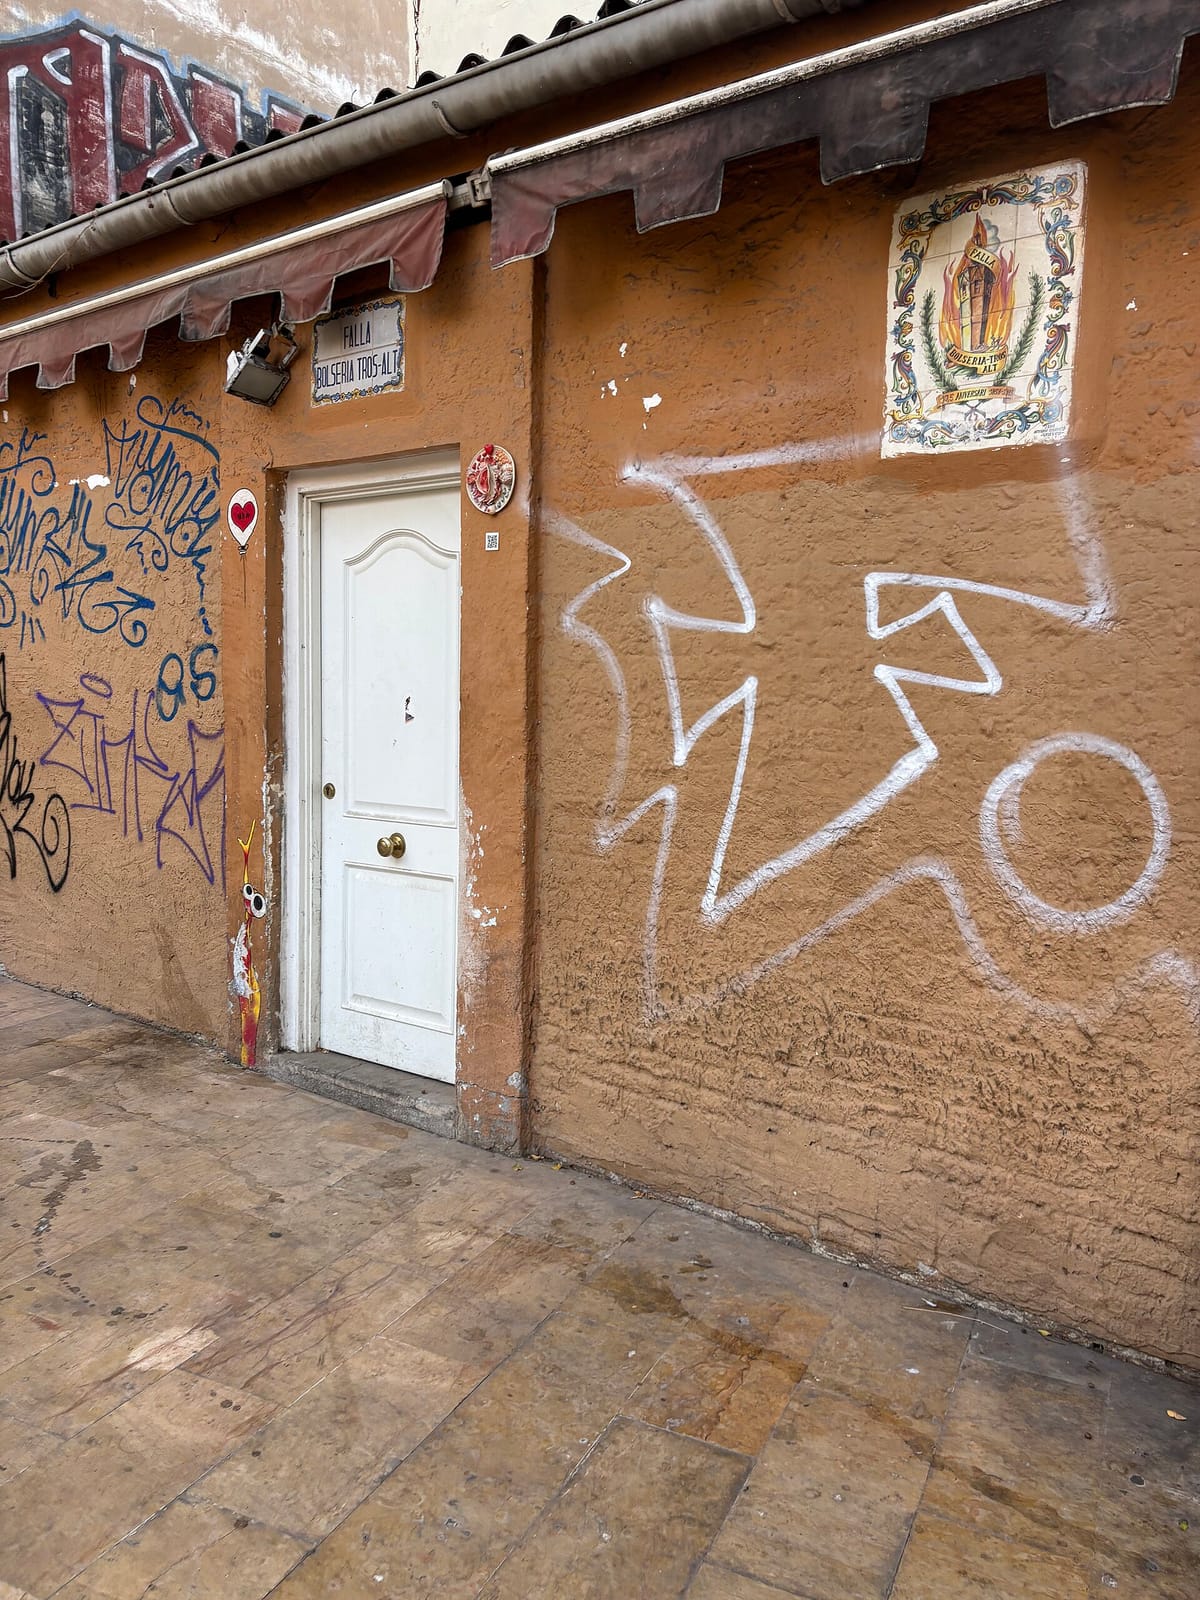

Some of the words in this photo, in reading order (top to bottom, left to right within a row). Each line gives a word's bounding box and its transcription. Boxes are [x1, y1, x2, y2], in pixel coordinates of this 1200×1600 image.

[970, 248, 996, 269] FALLA
[343, 320, 371, 349] FALLA
[316, 359, 354, 389] BOLSERIA
[357, 349, 398, 380] TROS-ALT
[982, 364, 997, 373] ALT
